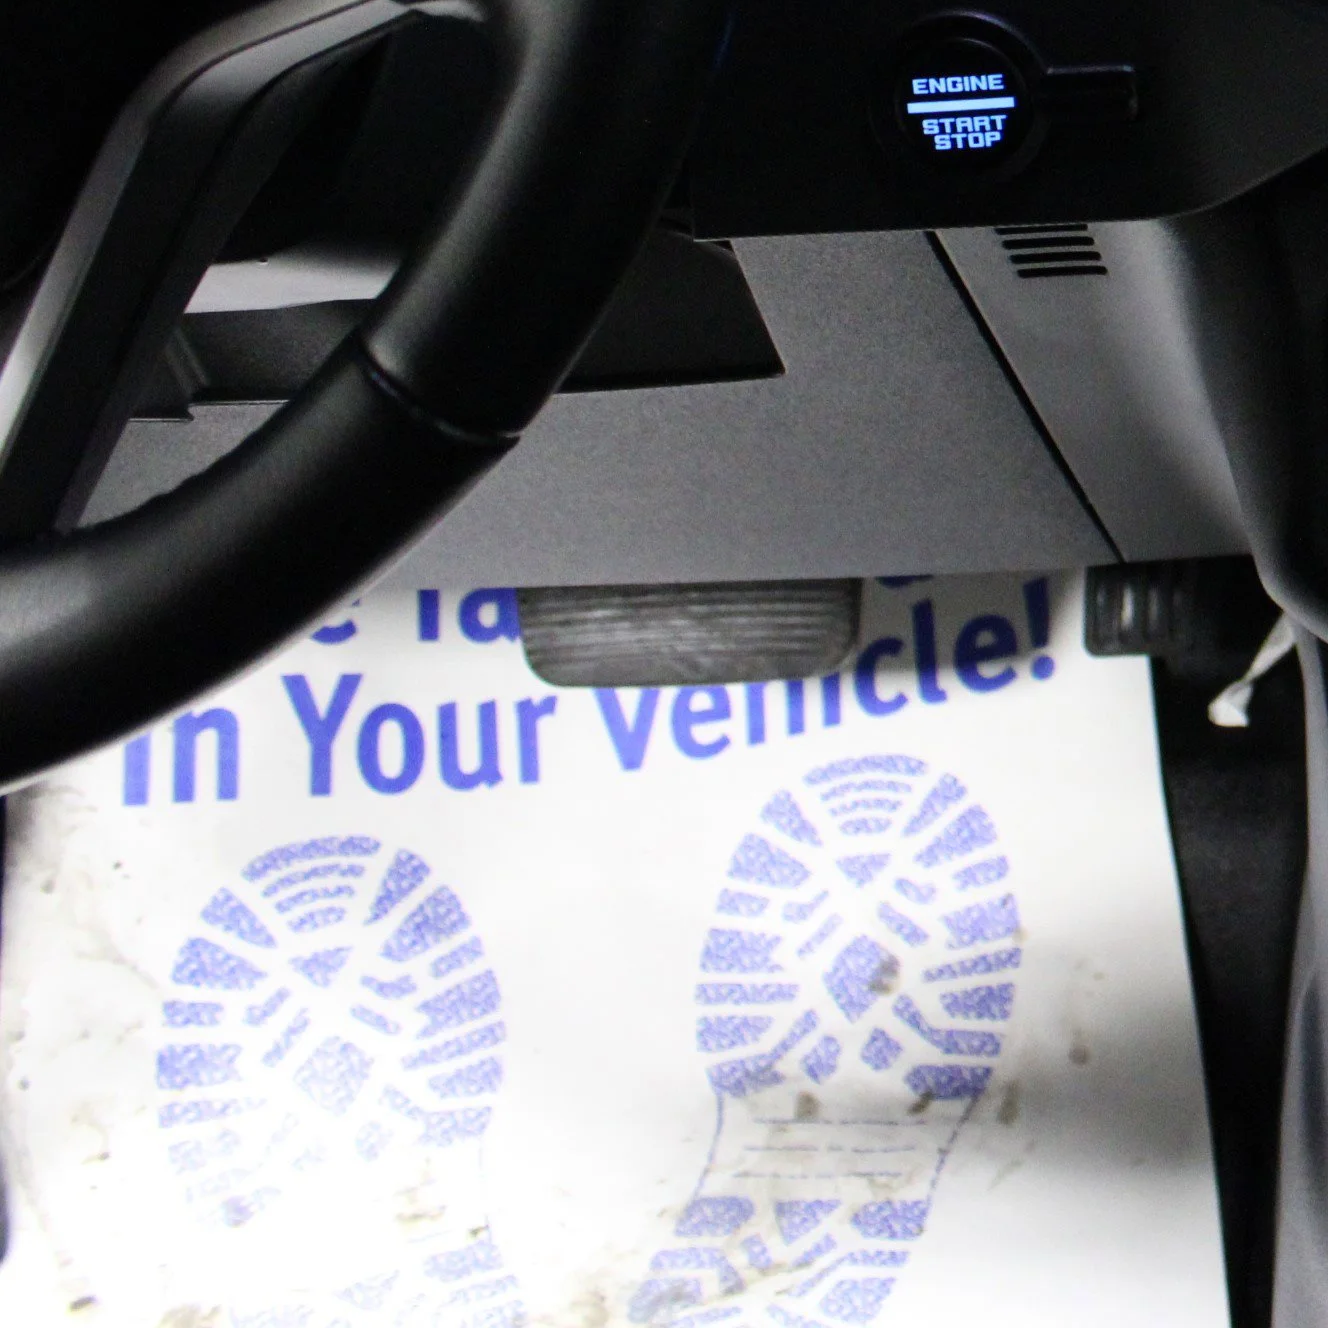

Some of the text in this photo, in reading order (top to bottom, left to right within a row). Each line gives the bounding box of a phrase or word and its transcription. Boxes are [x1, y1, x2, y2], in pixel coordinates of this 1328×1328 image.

[912, 74, 1004, 94] ENGINE
[922, 115, 1006, 134] START
[934, 131, 1001, 150] STOP
[281, 673, 558, 796] Your
